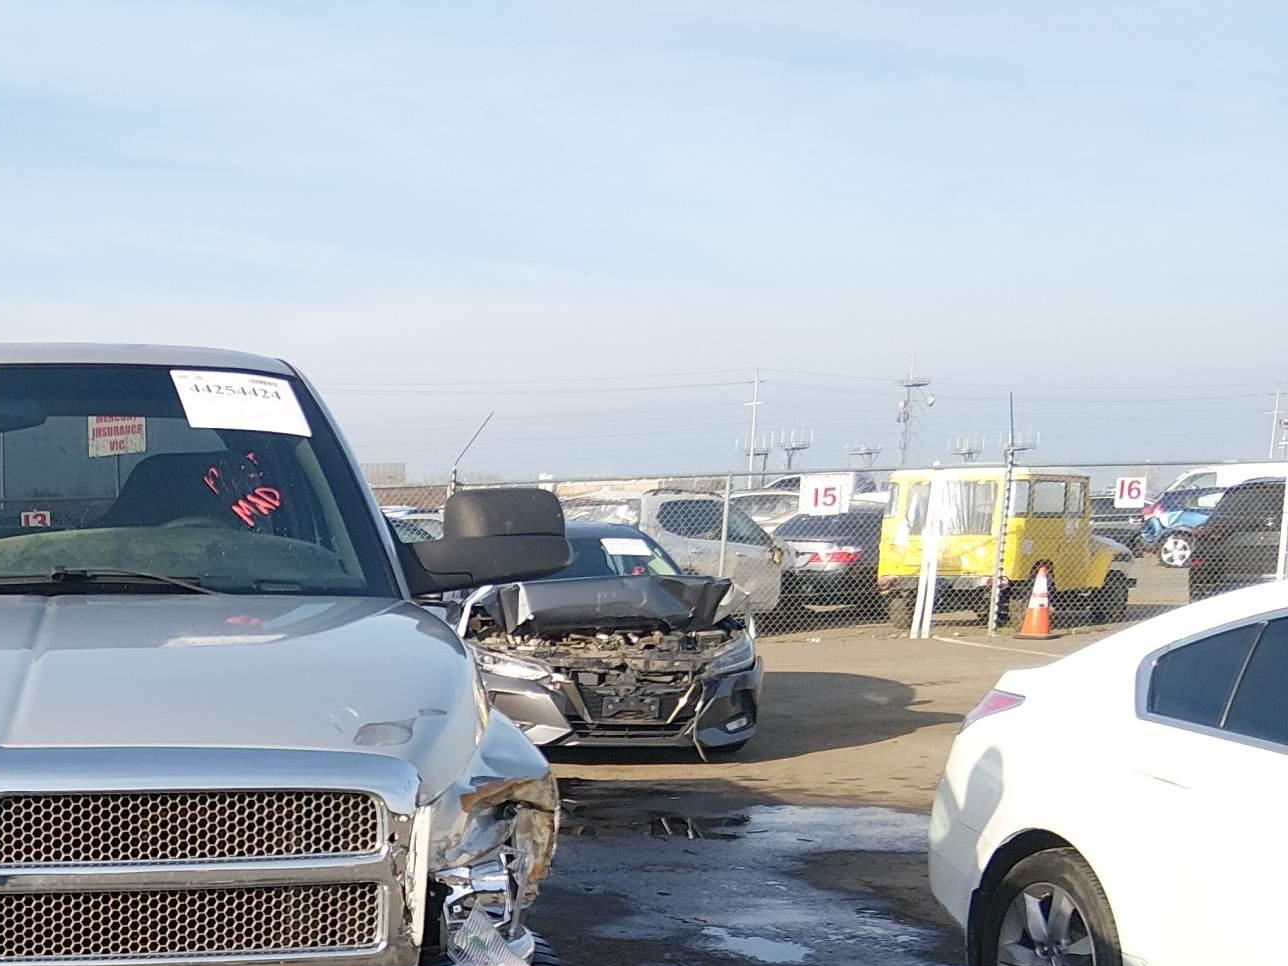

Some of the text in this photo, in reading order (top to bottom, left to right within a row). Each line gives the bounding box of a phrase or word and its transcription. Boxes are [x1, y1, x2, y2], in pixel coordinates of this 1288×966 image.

[190, 383, 281, 401] 44254424
[109, 440, 125, 452] VIC
[813, 486, 837, 508] 15
[1119, 479, 1142, 500] 16
